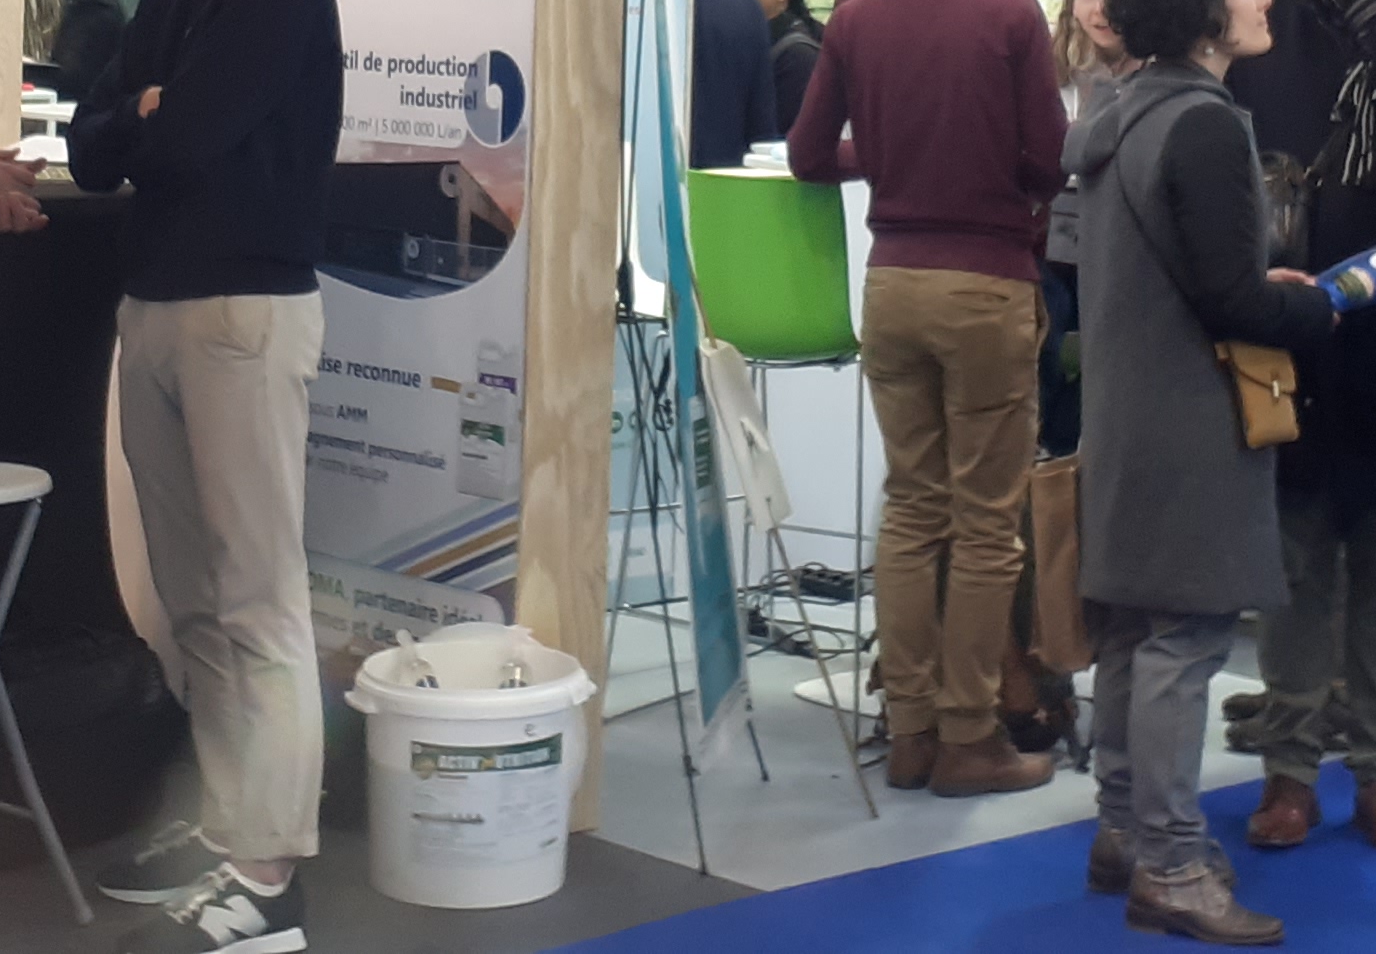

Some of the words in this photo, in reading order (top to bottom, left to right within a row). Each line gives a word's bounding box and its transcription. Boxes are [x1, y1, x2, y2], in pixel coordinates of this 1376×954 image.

[363, 51, 382, 72] de
[388, 54, 478, 79] production
[400, 85, 478, 111] industriel
[346, 360, 421, 388] reconnue
